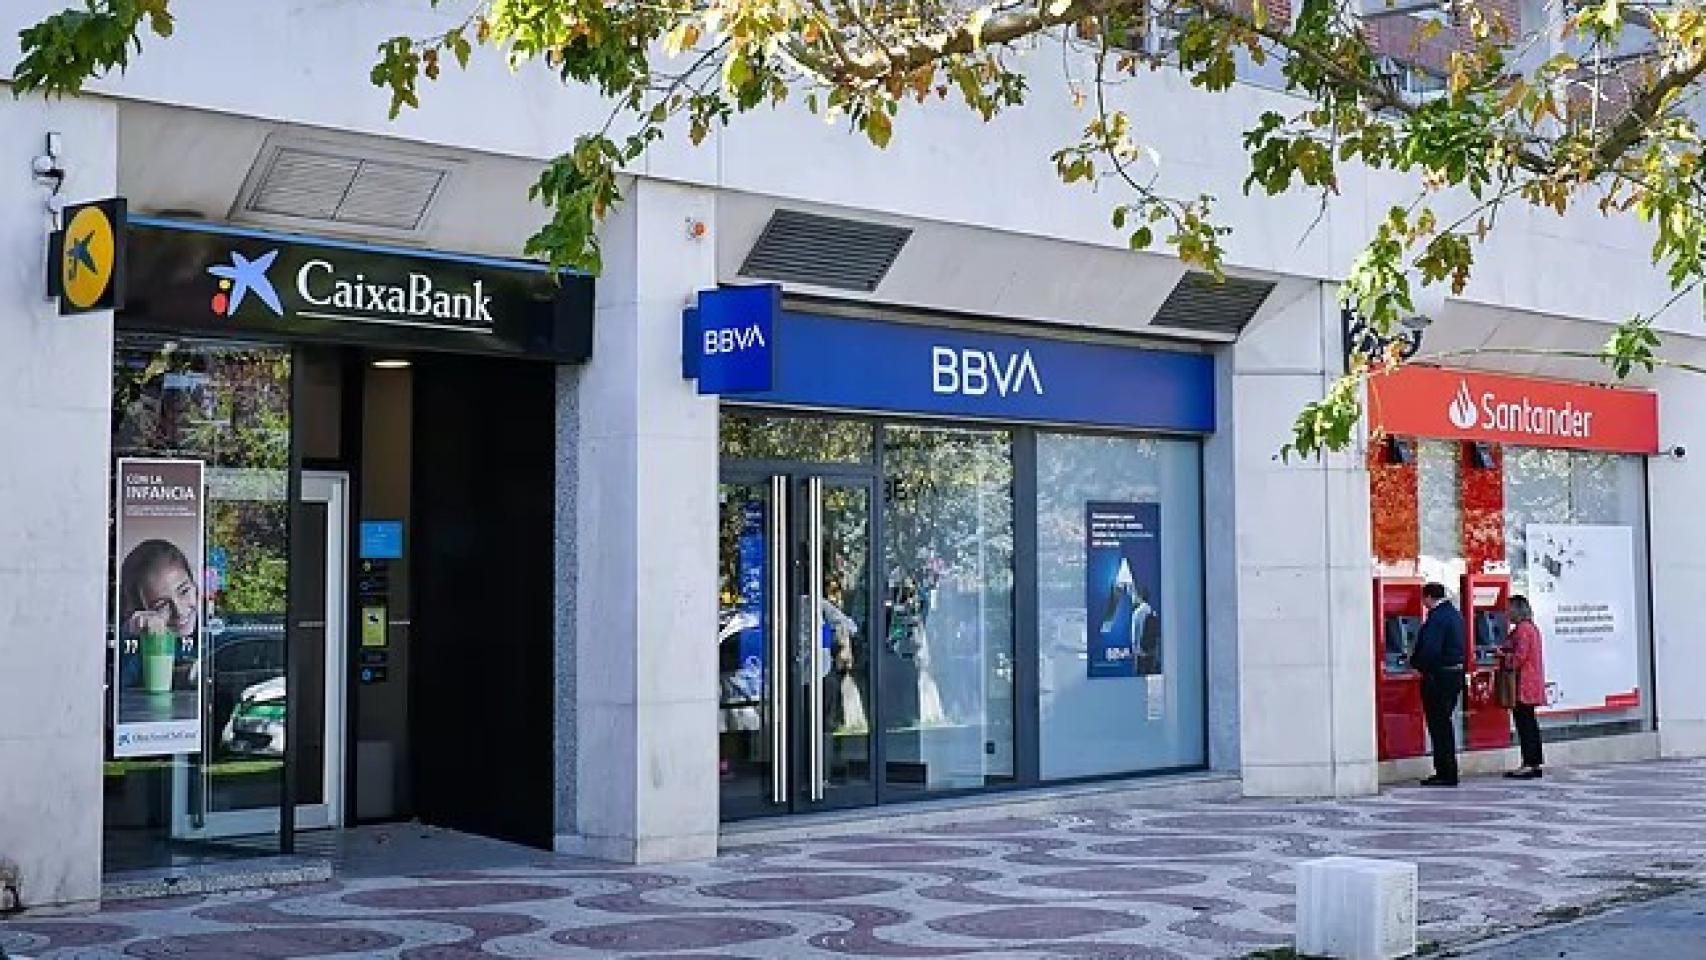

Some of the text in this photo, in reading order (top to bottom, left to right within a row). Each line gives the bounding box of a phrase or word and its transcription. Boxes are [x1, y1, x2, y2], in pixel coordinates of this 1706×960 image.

[296, 258, 493, 321] CaixaBank
[703, 323, 765, 355] BBVA
[933, 345, 1043, 398] BBVA
[1481, 392, 1592, 437] Santander
[126, 473, 163, 485] CON LA
[126, 486, 196, 501] INFANCIA
